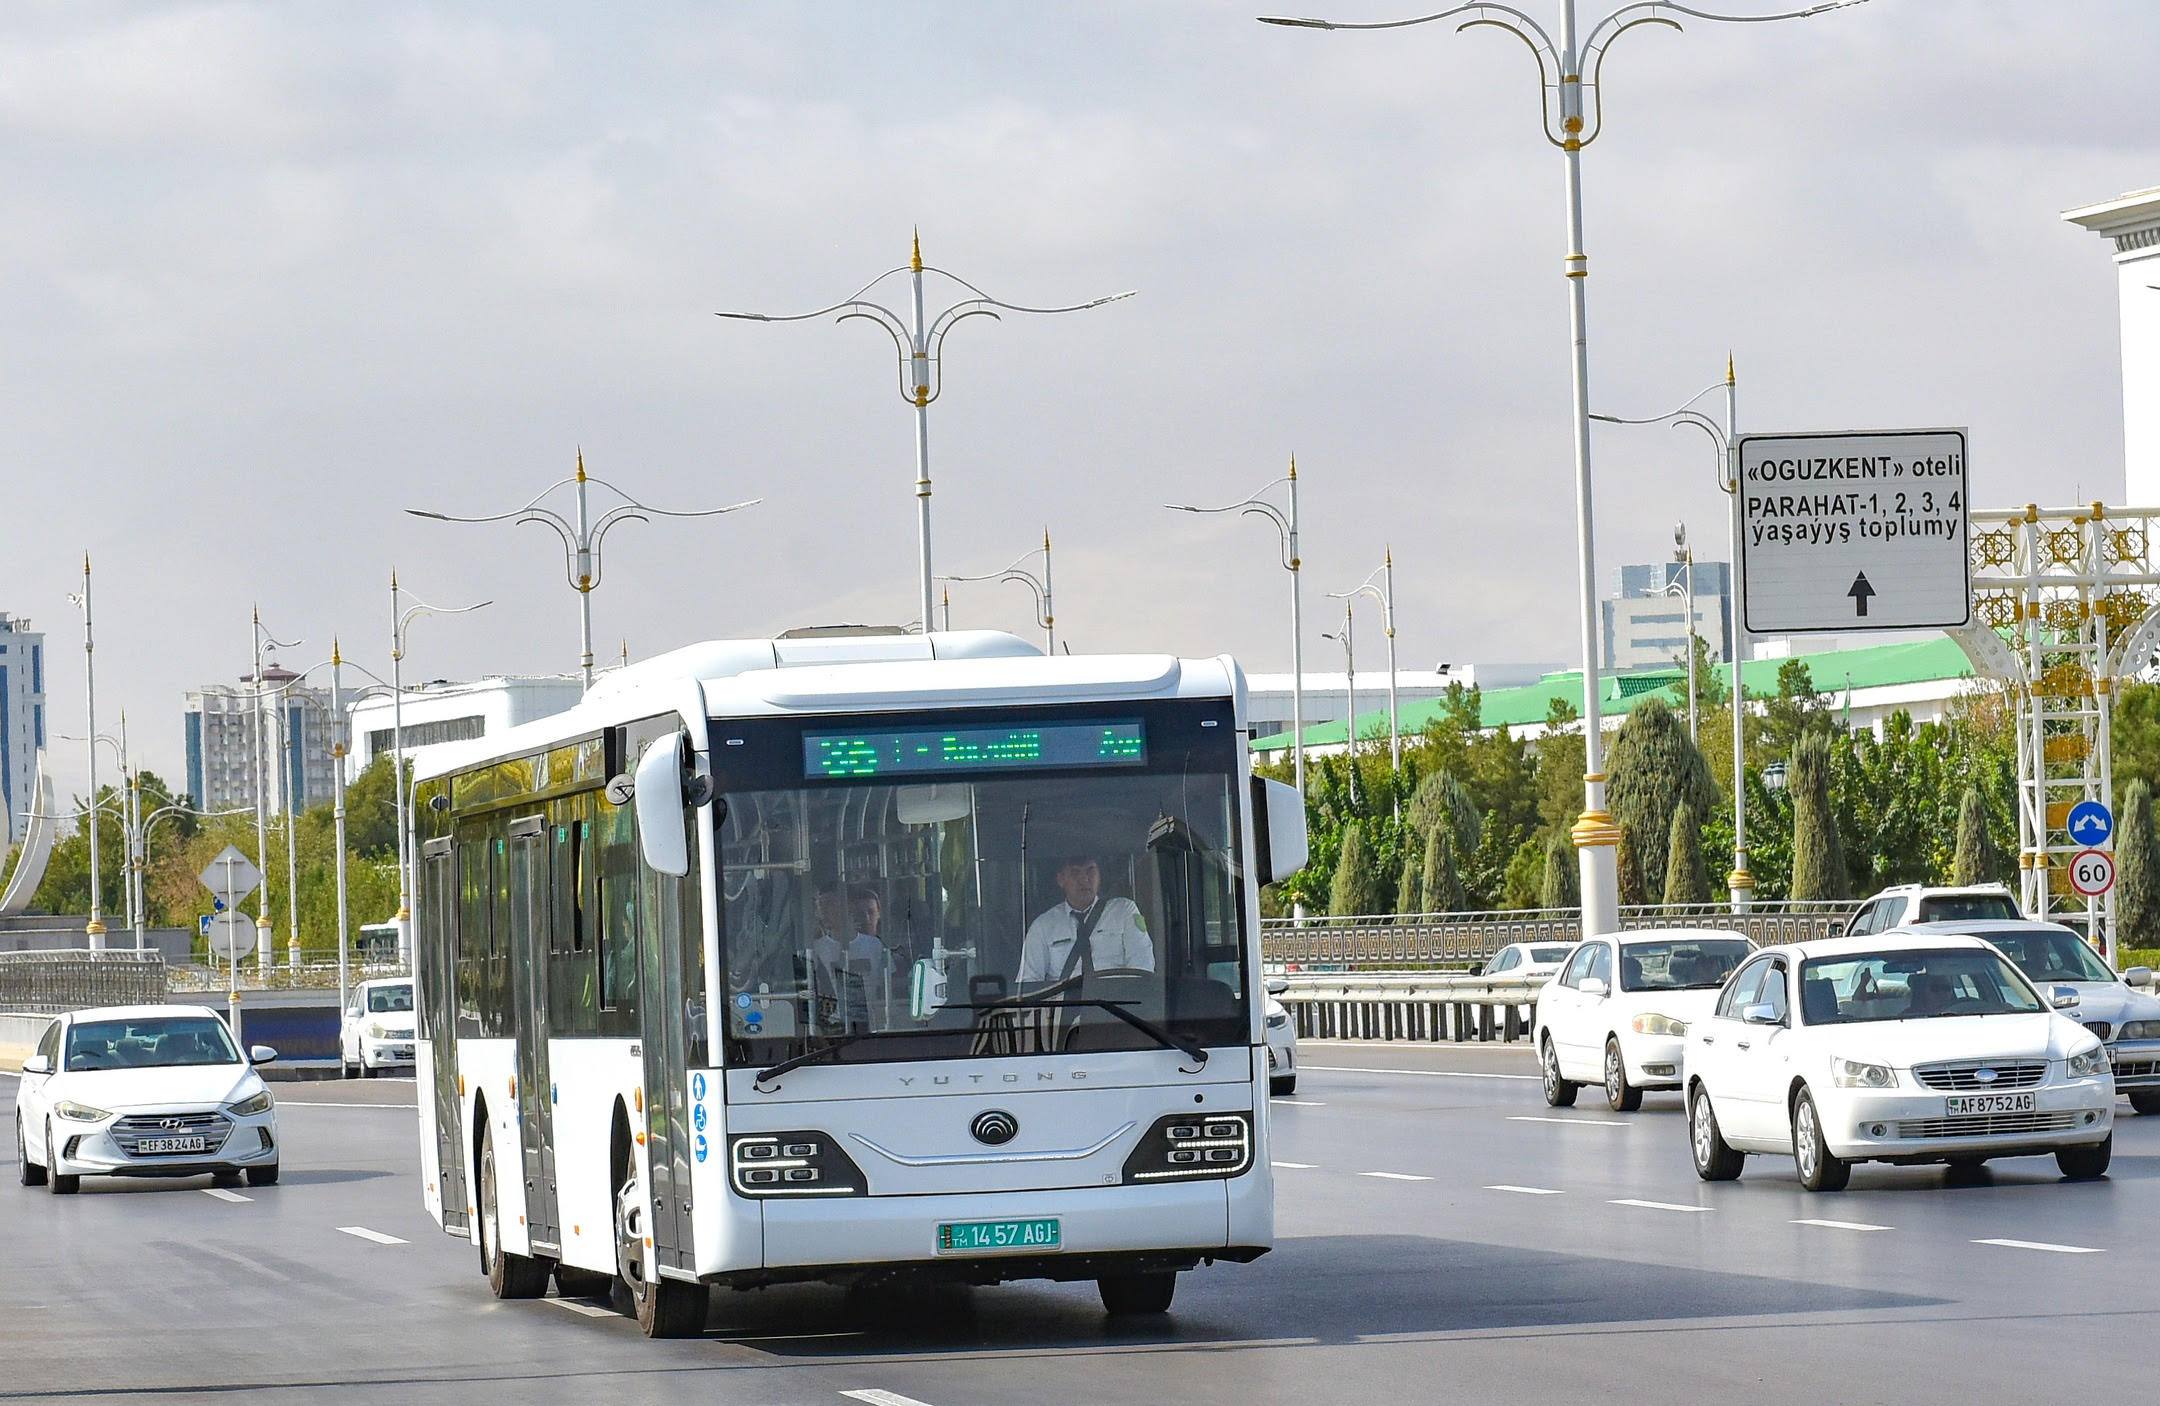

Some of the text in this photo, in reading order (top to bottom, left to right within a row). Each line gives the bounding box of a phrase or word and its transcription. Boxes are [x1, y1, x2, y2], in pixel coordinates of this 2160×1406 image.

[1748, 454, 1960, 482] «OGUZKENT» oteli
[1948, 490, 1961, 512] 4
[1752, 515, 1958, 546] ýaşaýyş toplumy
[2078, 864, 2106, 883] 60
[899, 1070, 1087, 1087] YUTONG
[951, 1238, 968, 1247] TM
